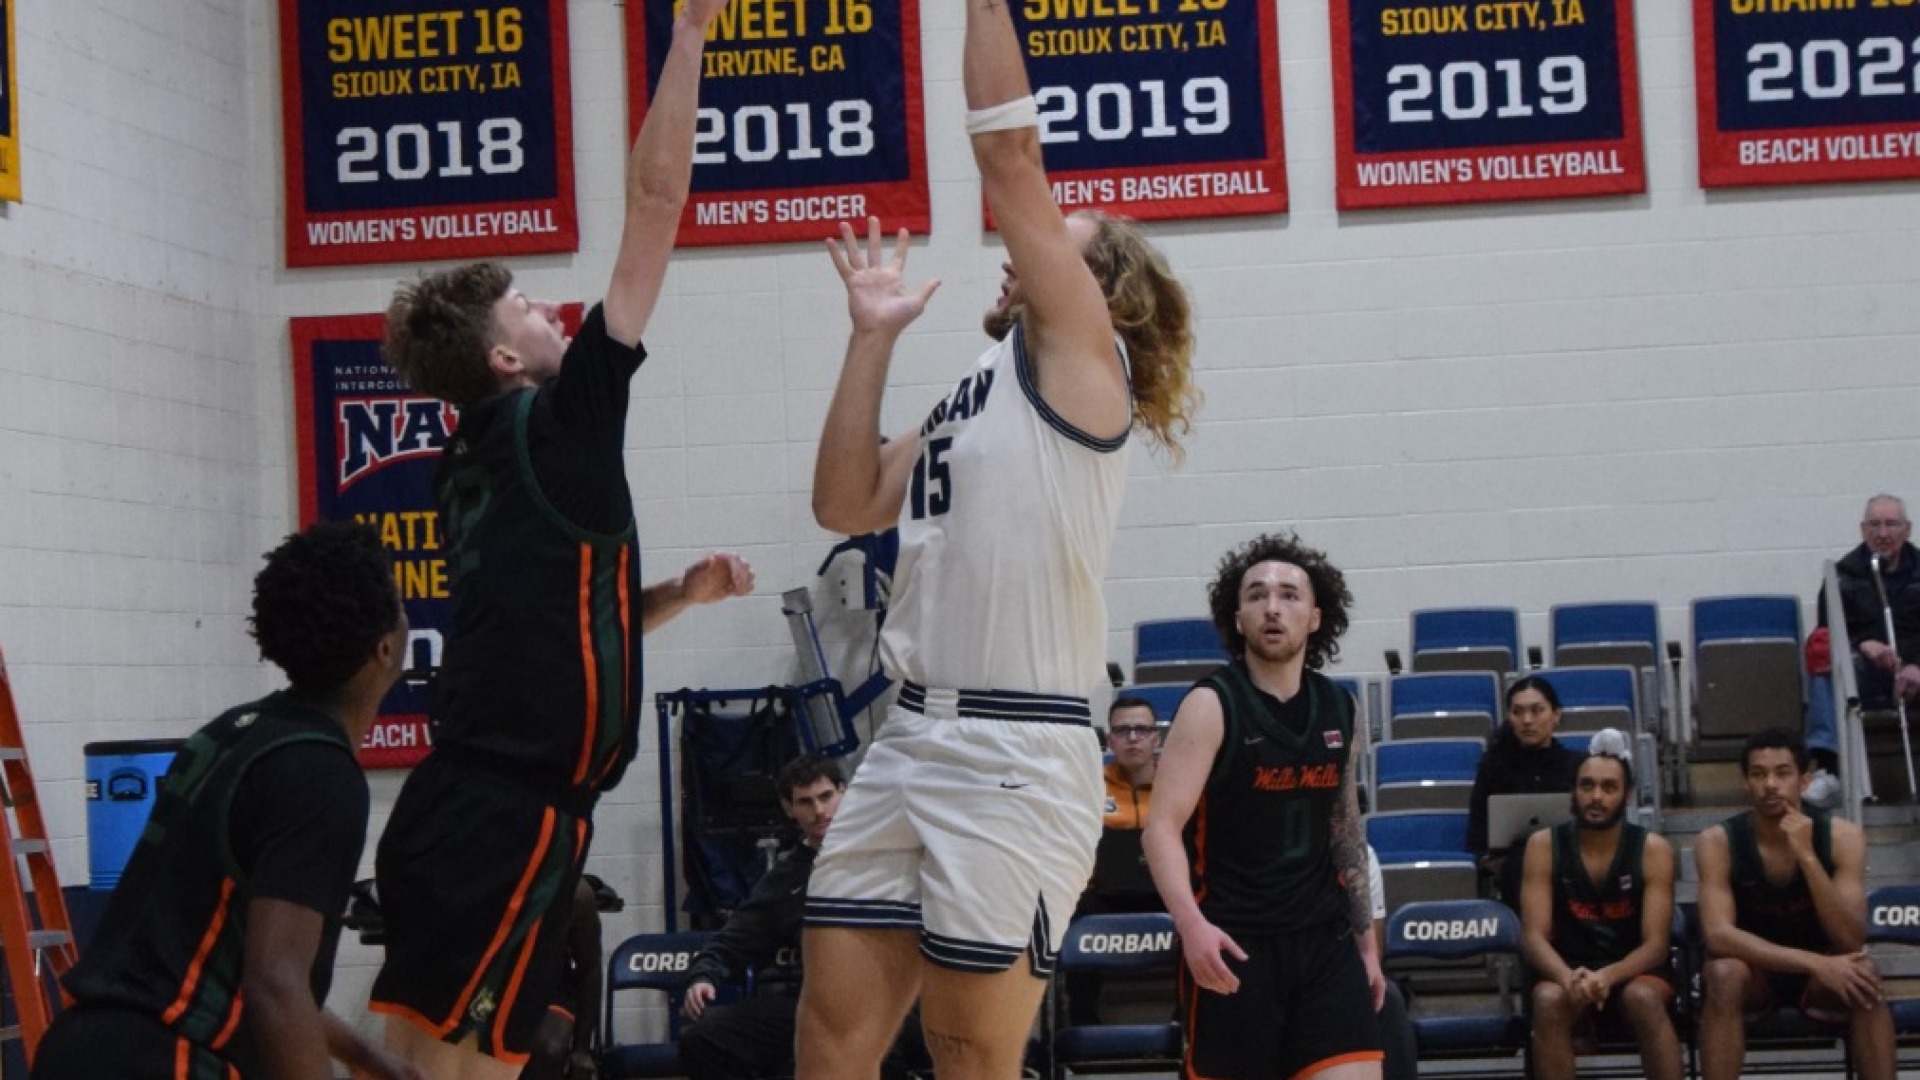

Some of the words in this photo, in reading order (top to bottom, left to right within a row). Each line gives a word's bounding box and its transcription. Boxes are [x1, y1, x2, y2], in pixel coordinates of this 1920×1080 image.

[327, 10, 464, 63] SWEET
[474, 7, 523, 54] 16
[673, 0, 806, 41] WEET
[823, 0, 873, 35] 16
[1381, 6, 1468, 36] SIOUX
[1475, 2, 1547, 31] CITY,
[1553, 0, 1585, 26] IA
[1028, 26, 1112, 57] SIOUX
[1120, 23, 1189, 52] CITY,
[1195, 20, 1227, 47] IA
[332, 68, 413, 98] SIOUX
[420, 64, 486, 93] CITY,
[491, 62, 521, 88] IA
[703, 48, 804, 78] IRVINE,
[811, 45, 846, 72] CA
[1746, 36, 1920, 102] 202
[1386, 55, 1588, 123] 2019
[1035, 76, 1231, 144] 2019
[336, 117, 524, 183] 2018
[692, 99, 874, 164] 2018
[1357, 158, 1473, 187] WOMEN'S
[1478, 150, 1625, 180] VOLLEYBALL
[1739, 137, 1820, 166] BEACH
[1121, 169, 1270, 201] BASKETBALL
[307, 217, 416, 246] WOMEN'S
[421, 208, 558, 240] VOLLEYBALL
[696, 199, 769, 225] MEN'S
[775, 194, 866, 221] SOCCER
[911, 436, 953, 521] 15
[1079, 931, 1173, 954] CORBAN
[1403, 918, 1498, 940] CORBAN
[629, 951, 698, 972] CORB
